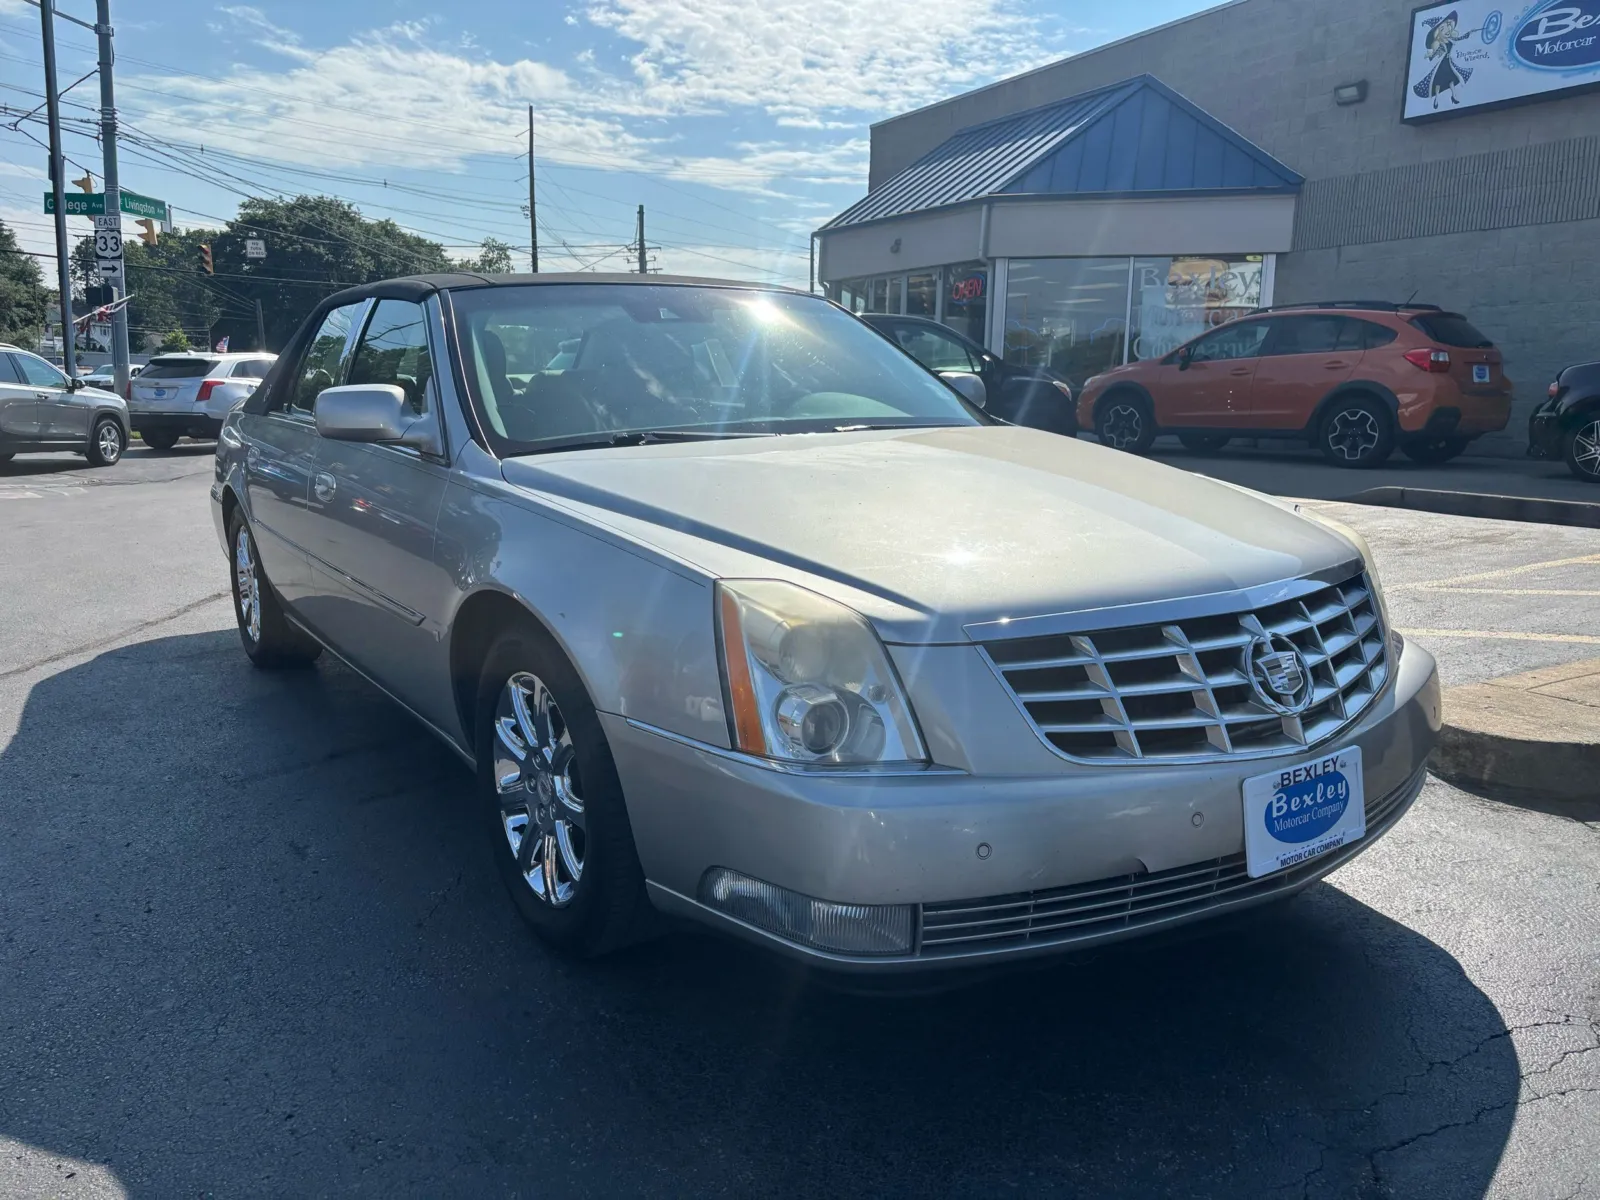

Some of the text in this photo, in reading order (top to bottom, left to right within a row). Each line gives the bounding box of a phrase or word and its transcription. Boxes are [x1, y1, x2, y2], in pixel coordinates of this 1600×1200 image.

[1520, 7, 1600, 41] Be
[1534, 35, 1597, 57] Motorcar
[46, 198, 88, 213] Clege
[124, 196, 156, 215] Livingston
[98, 217, 117, 227] EAST
[98, 235, 119, 252] 33
[952, 278, 982, 300] OPEN
[1138, 265, 1260, 298] Bexley
[1280, 755, 1339, 787] BEXLEY
[1271, 779, 1346, 818] Bexley
[1274, 800, 1345, 833] Motorcar Company
[1280, 852, 1303, 867] MOTOR
[1303, 847, 1316, 859] CAR
[1316, 837, 1345, 854] COMPANY
